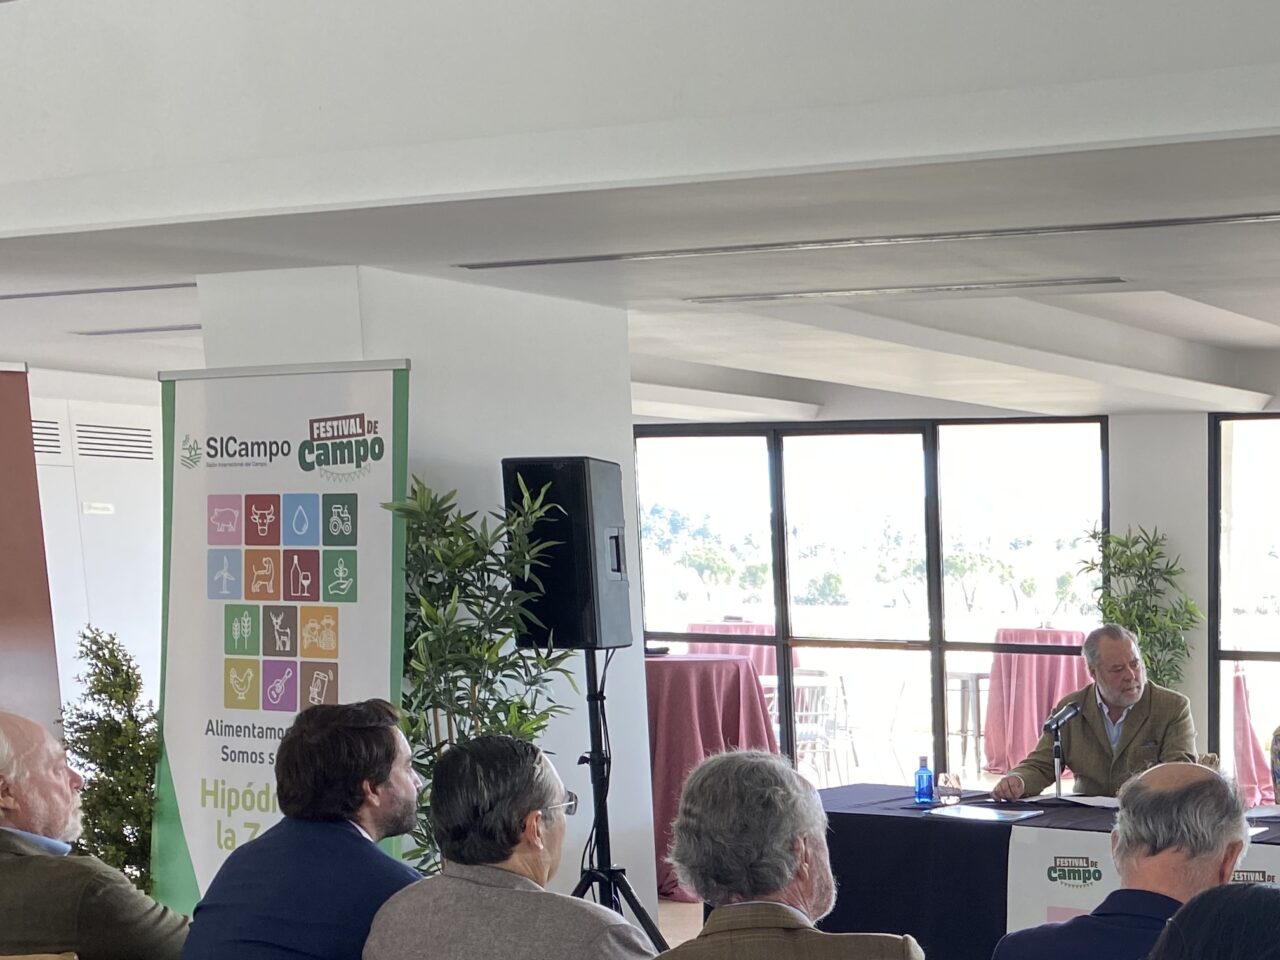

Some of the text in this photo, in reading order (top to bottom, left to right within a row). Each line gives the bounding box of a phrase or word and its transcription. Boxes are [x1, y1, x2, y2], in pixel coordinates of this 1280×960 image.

[312, 417, 378, 439] FESTIVAL DE
[206, 436, 291, 463] SICampo
[298, 436, 385, 471] Campo
[205, 719, 288, 741] Alimentamo
[221, 745, 265, 765] Somos
[201, 778, 277, 818] Hipódr
[217, 820, 236, 851] la
[1056, 858, 1088, 867] FESTIVAL
[1047, 866, 1102, 883] Campo
